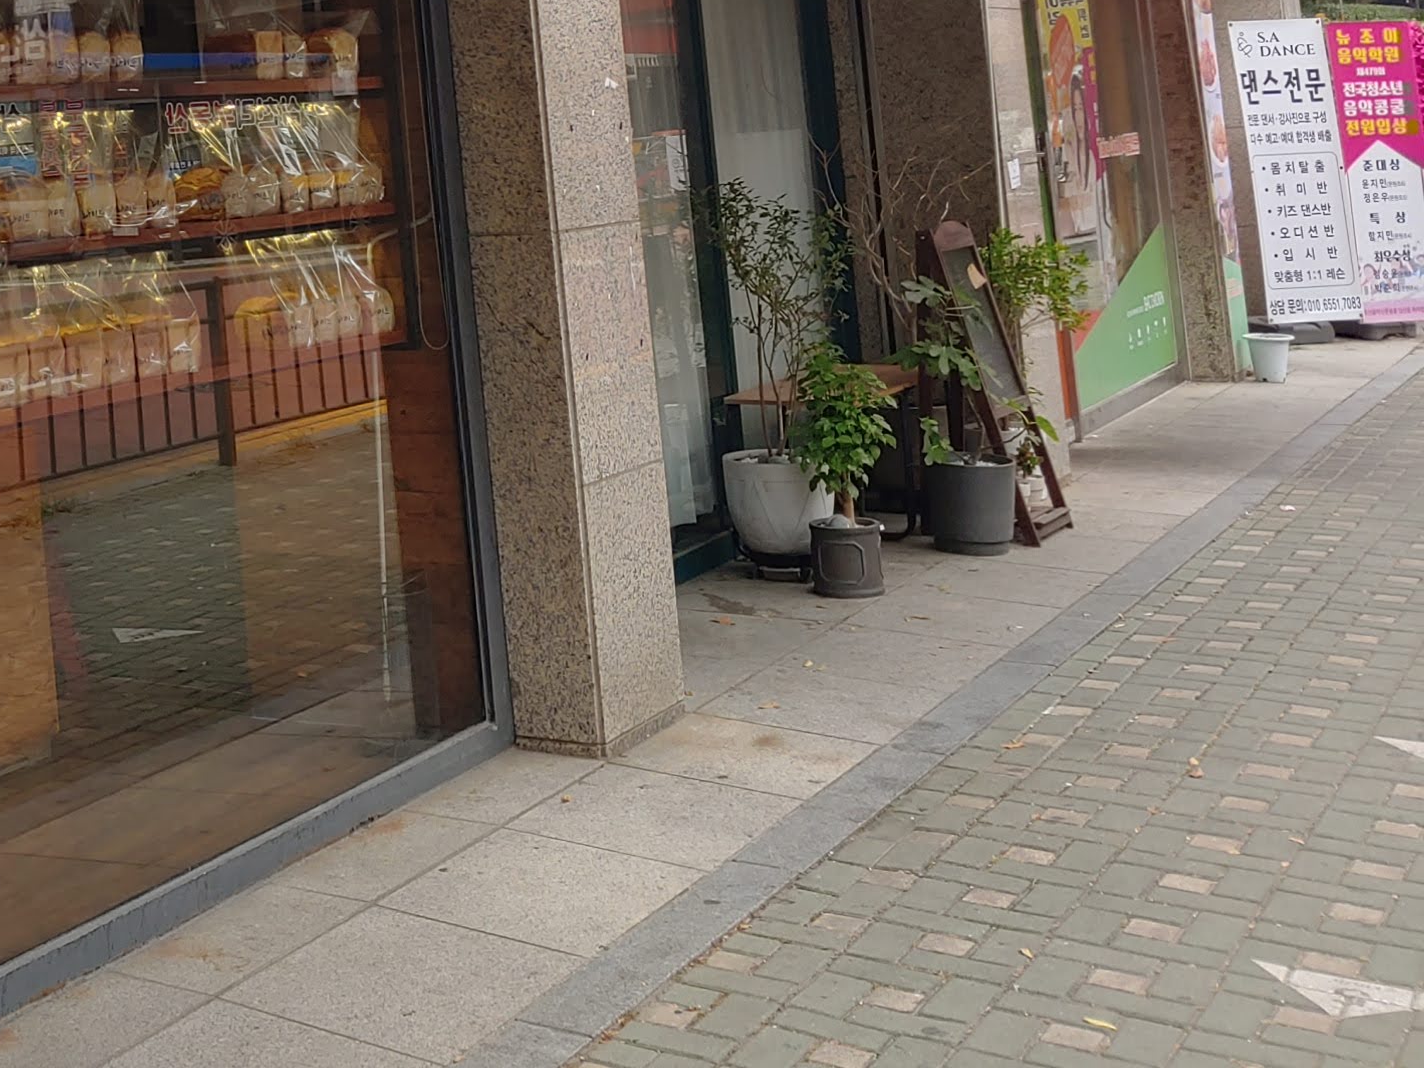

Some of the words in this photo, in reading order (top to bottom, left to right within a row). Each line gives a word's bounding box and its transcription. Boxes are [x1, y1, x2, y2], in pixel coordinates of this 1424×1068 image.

[1257, 31, 1280, 43] S.A
[1260, 44, 1316, 57] DANCE
[1337, 46, 1400, 64] 음악학원
[1240, 68, 1325, 105] 댄스전문
[1342, 80, 1404, 97] 전국청소년
[1344, 98, 1405, 117] 음악콩쿨
[1345, 117, 1407, 136] 전원입상
[1277, 205, 1298, 218] 키즈
[1301, 203, 1332, 217] 댄스반
[1326, 268, 1346, 281] 레슨
[1270, 299, 1285, 316] 상담
